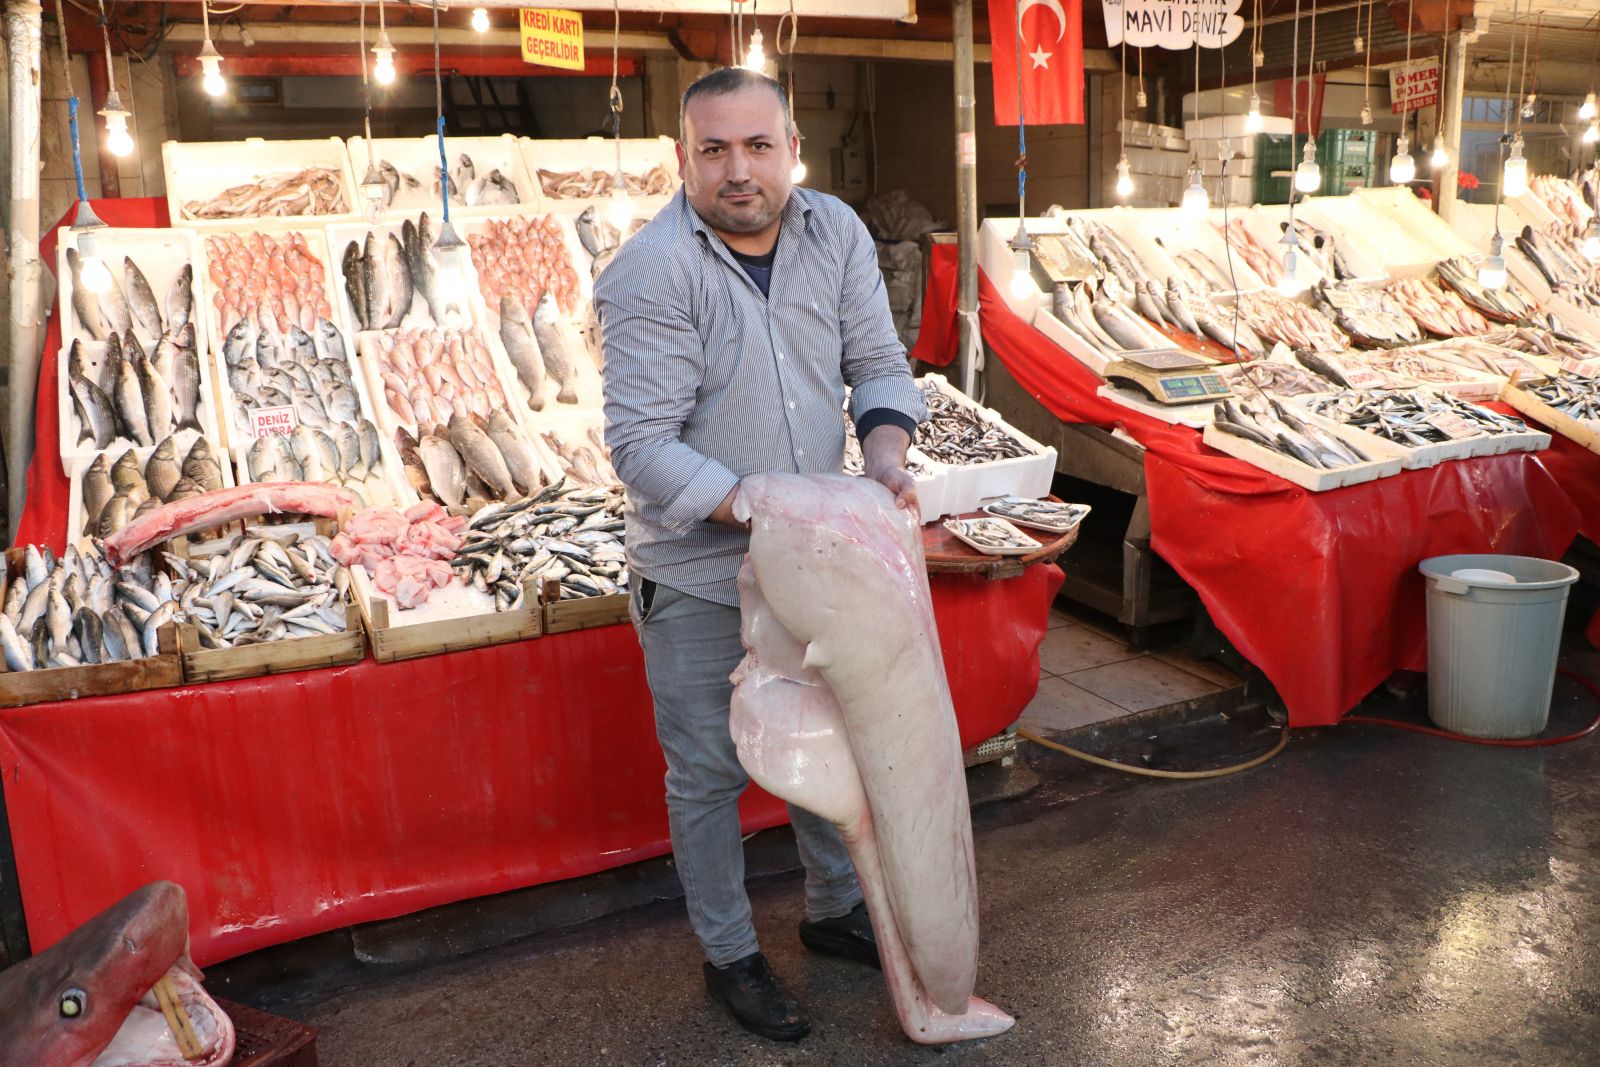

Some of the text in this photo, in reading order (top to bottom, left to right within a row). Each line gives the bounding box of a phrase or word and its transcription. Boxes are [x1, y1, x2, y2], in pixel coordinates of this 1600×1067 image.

[523, 9, 580, 37] KREDİ KARTI
[1126, 6, 1228, 35] MAVİ DENİZ
[527, 36, 580, 62] GEÇERLİDİR
[1395, 68, 1438, 86] ÖMER
[1396, 80, 1439, 99] POLAT
